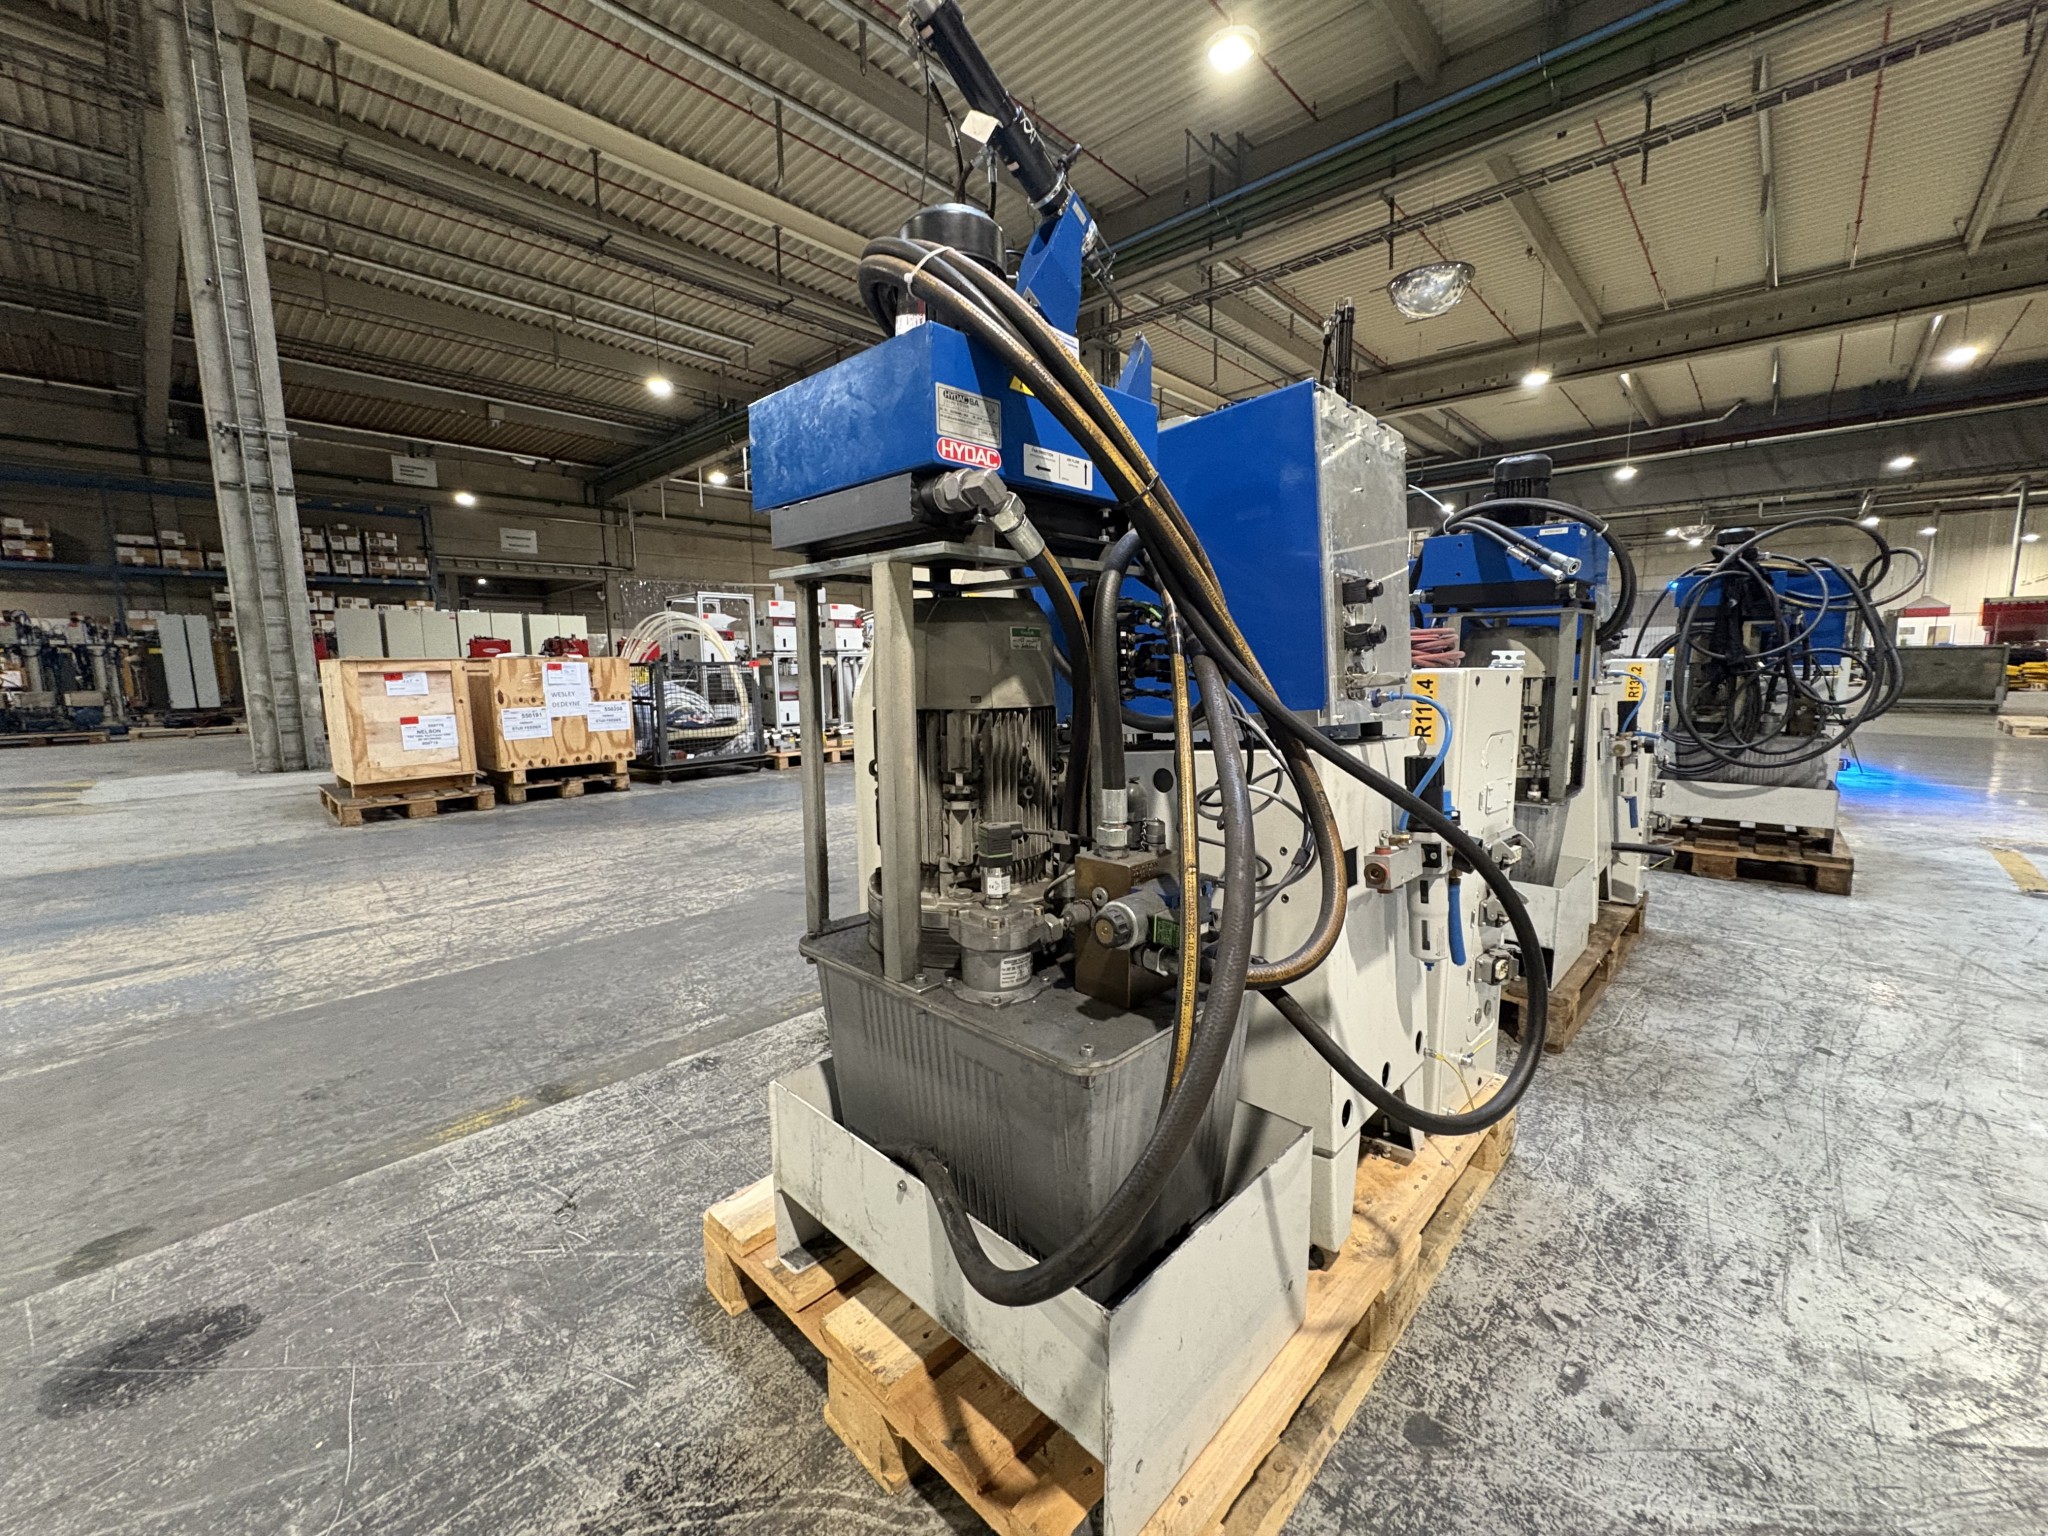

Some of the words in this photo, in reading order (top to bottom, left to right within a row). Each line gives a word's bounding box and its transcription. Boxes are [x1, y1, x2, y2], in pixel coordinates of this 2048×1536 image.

[943, 389, 969, 404] HYDAC
[941, 439, 998, 468] HYDAC
[1186, 954, 1194, 978] Made
[1185, 979, 1192, 987] in
[1183, 988, 1192, 1006] Italy
